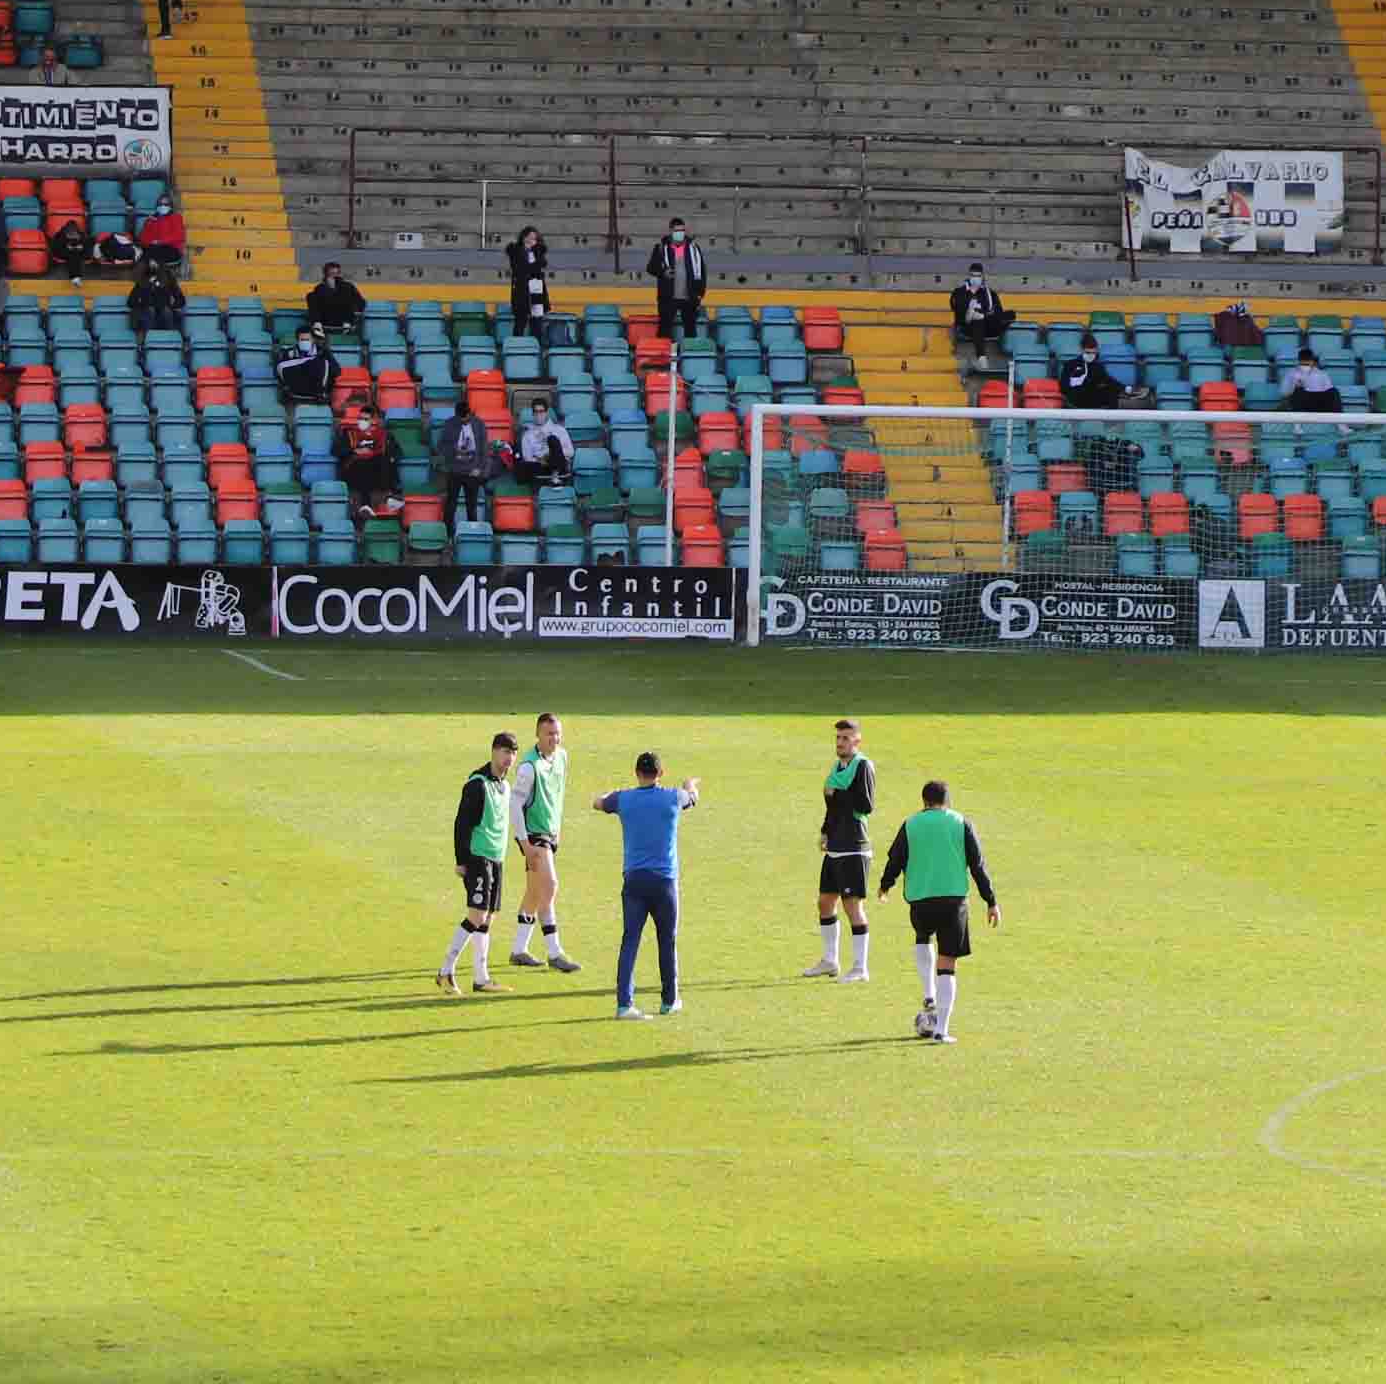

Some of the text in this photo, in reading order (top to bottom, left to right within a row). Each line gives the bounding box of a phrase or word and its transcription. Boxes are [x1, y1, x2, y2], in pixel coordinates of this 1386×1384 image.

[1191, 161, 1330, 187] CALVARIO
[1151, 209, 1203, 229] PEÑA
[569, 567, 709, 594] Centro
[279, 571, 534, 634] CocoMiel
[555, 591, 721, 617] Infantil
[807, 591, 943, 615] CONDE DAVID
[1041, 596, 1176, 620] CONDE DAVID
[541, 618, 727, 636] www.grupococomiel.com
[847, 628, 876, 640] 923
[878, 629, 909, 641] 240
[912, 629, 942, 641] 623
[1081, 631, 1109, 644] 923
[1113, 632, 1143, 645] 240
[1145, 633, 1175, 646] 623
